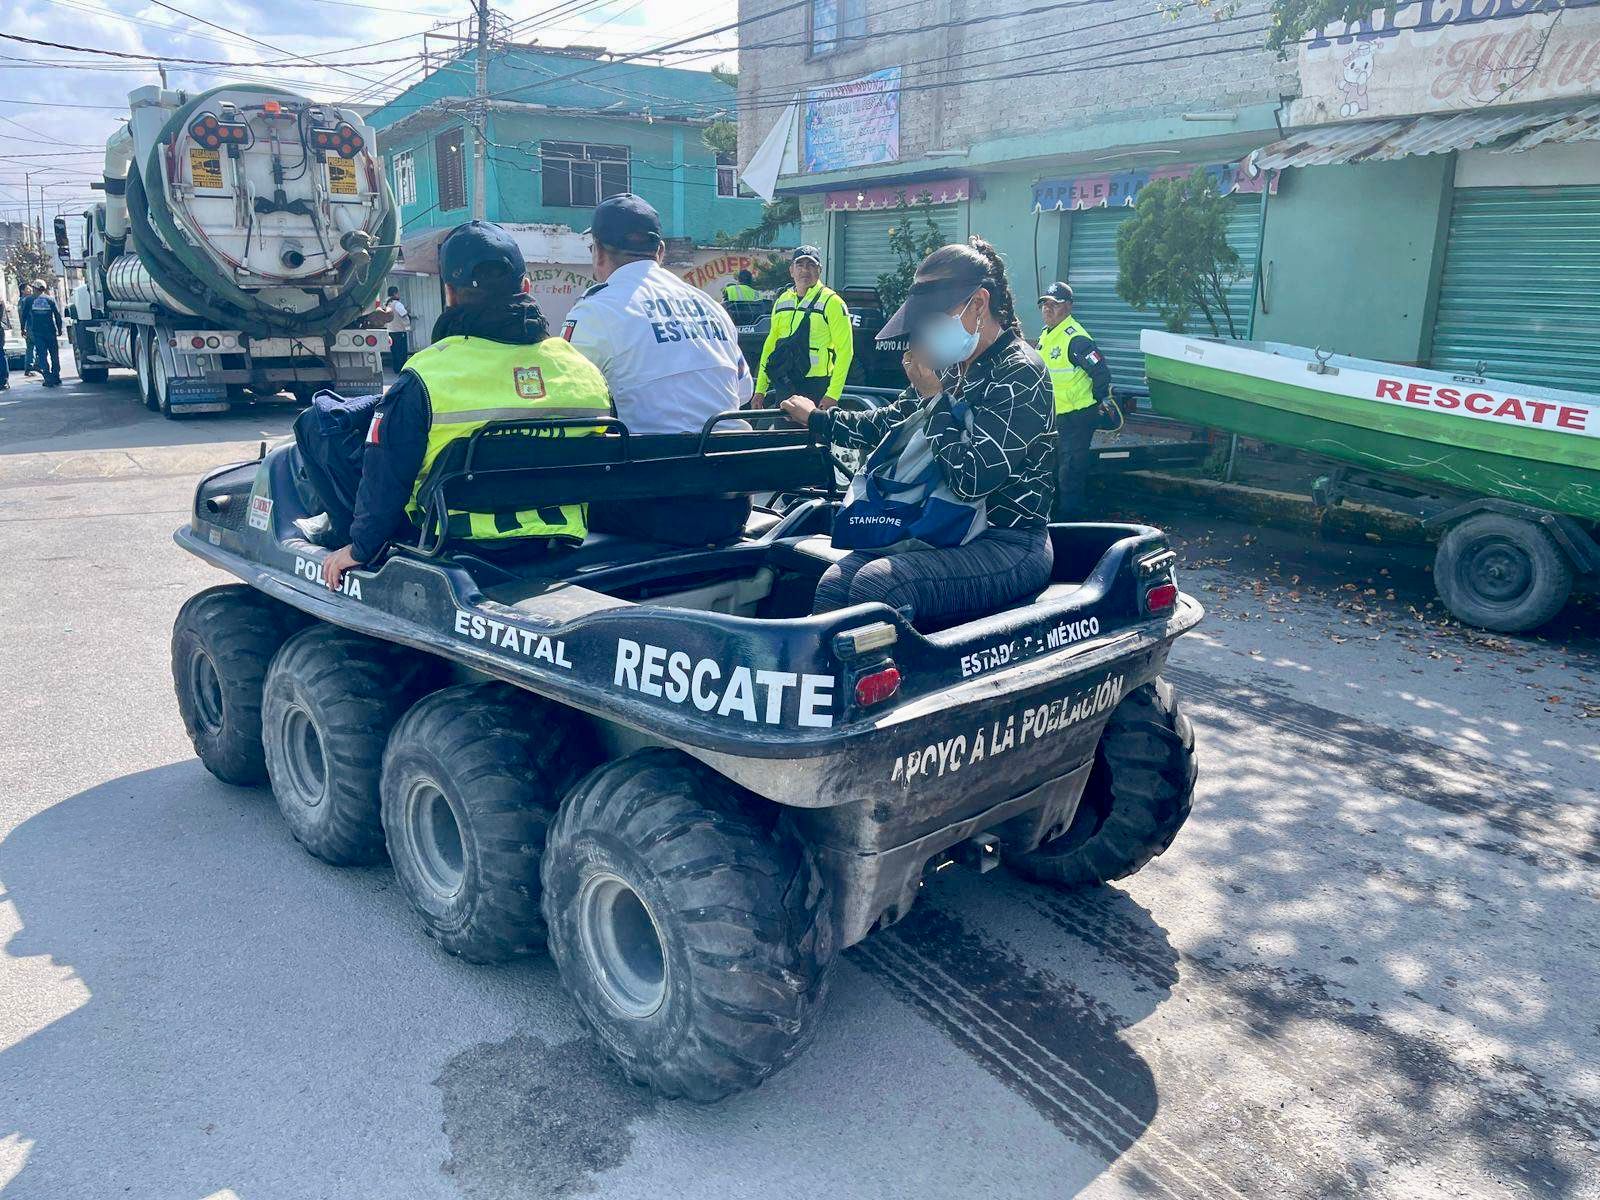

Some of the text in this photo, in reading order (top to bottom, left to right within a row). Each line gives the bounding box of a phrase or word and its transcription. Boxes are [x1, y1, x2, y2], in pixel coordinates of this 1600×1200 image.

[684, 255, 762, 288] TAQUER
[651, 319, 728, 344] ESTATAL
[875, 341, 896, 351] APOYO
[896, 341, 902, 351] A
[1376, 378, 1589, 430] RESCATE
[849, 516, 902, 527] STANHOME
[295, 556, 362, 600] POLÍA
[454, 610, 572, 669] ESTATAL
[1046, 616, 1100, 650] MÉXICO
[613, 638, 835, 728] RESCATE
[968, 728, 986, 766] A
[989, 714, 1016, 757] LA
